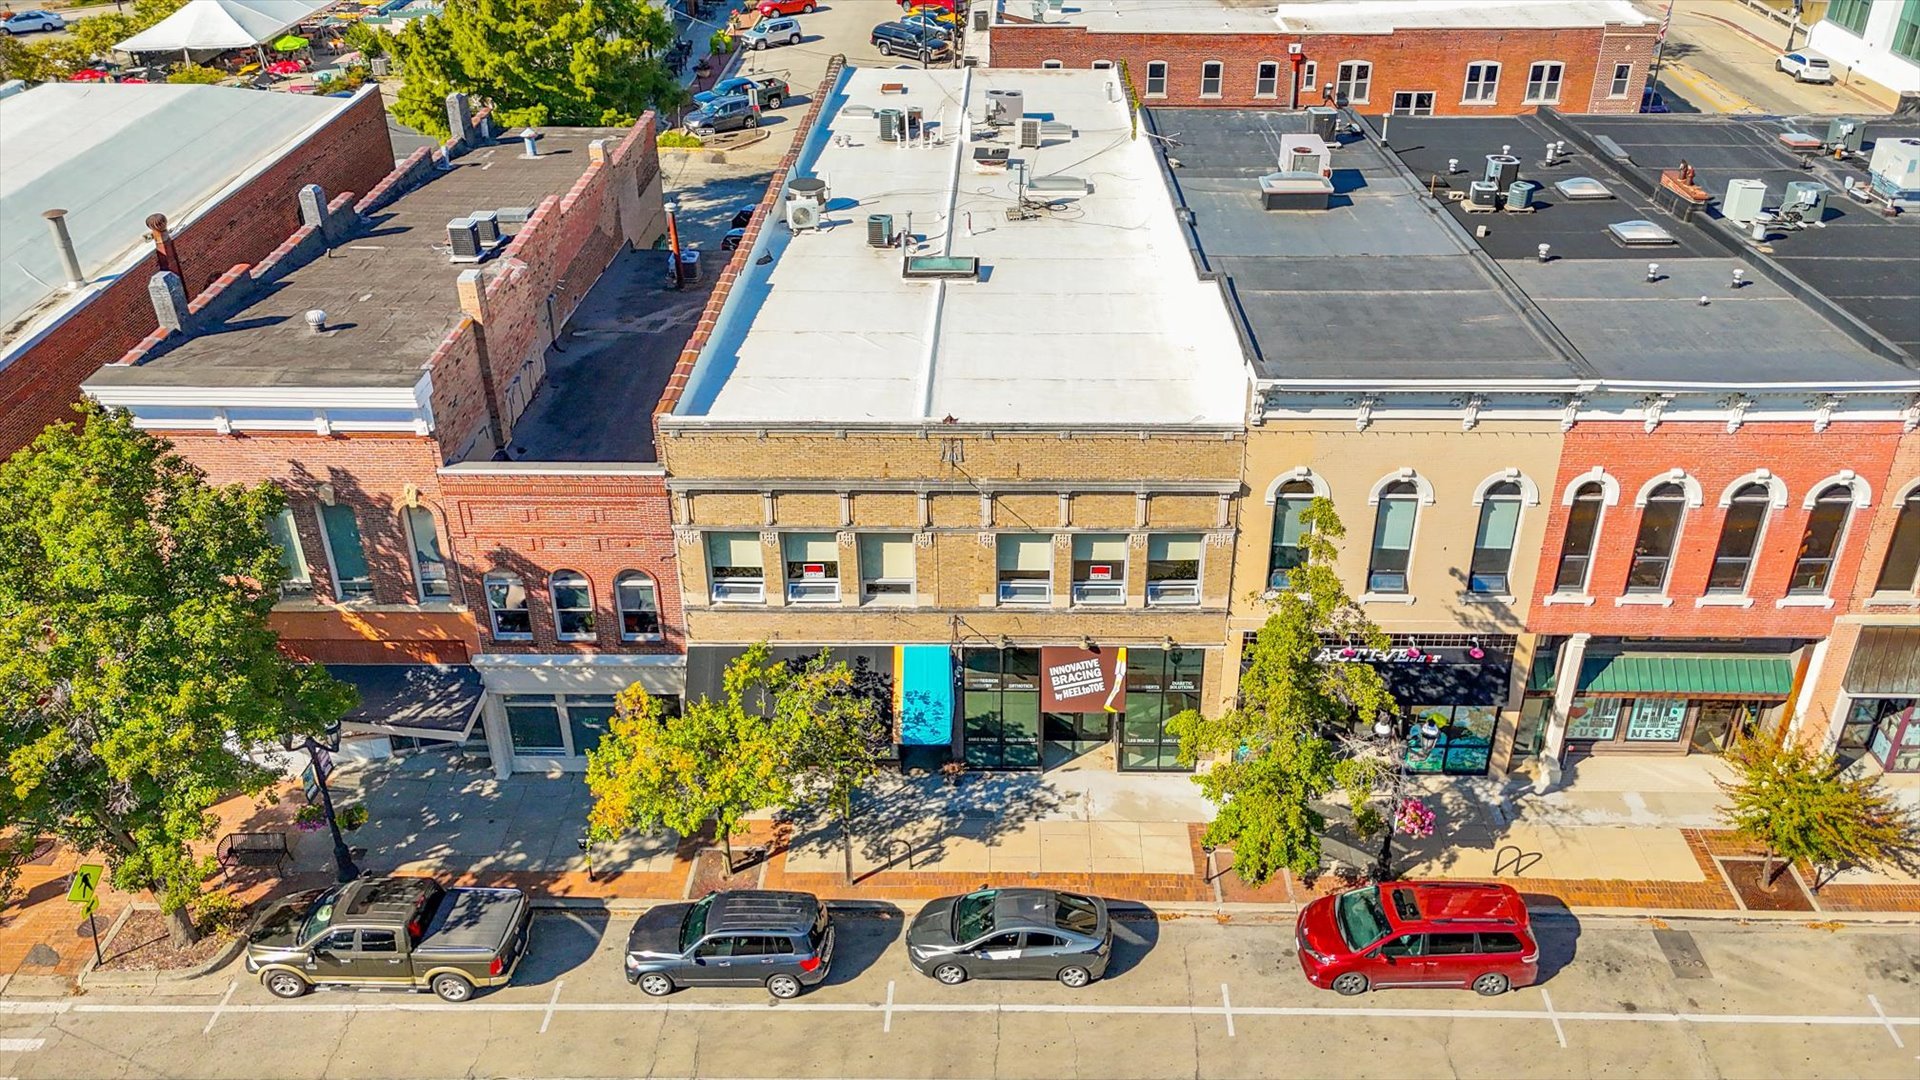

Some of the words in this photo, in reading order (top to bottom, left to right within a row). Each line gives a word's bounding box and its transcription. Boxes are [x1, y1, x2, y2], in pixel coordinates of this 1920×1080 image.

[1049, 658, 1100, 676] INNOVATIVE
[1051, 668, 1103, 687] BRACING
[1055, 692, 1063, 701] by
[1062, 682, 1106, 699] HEELtoTOE
[1631, 728, 1672, 738] NESS
